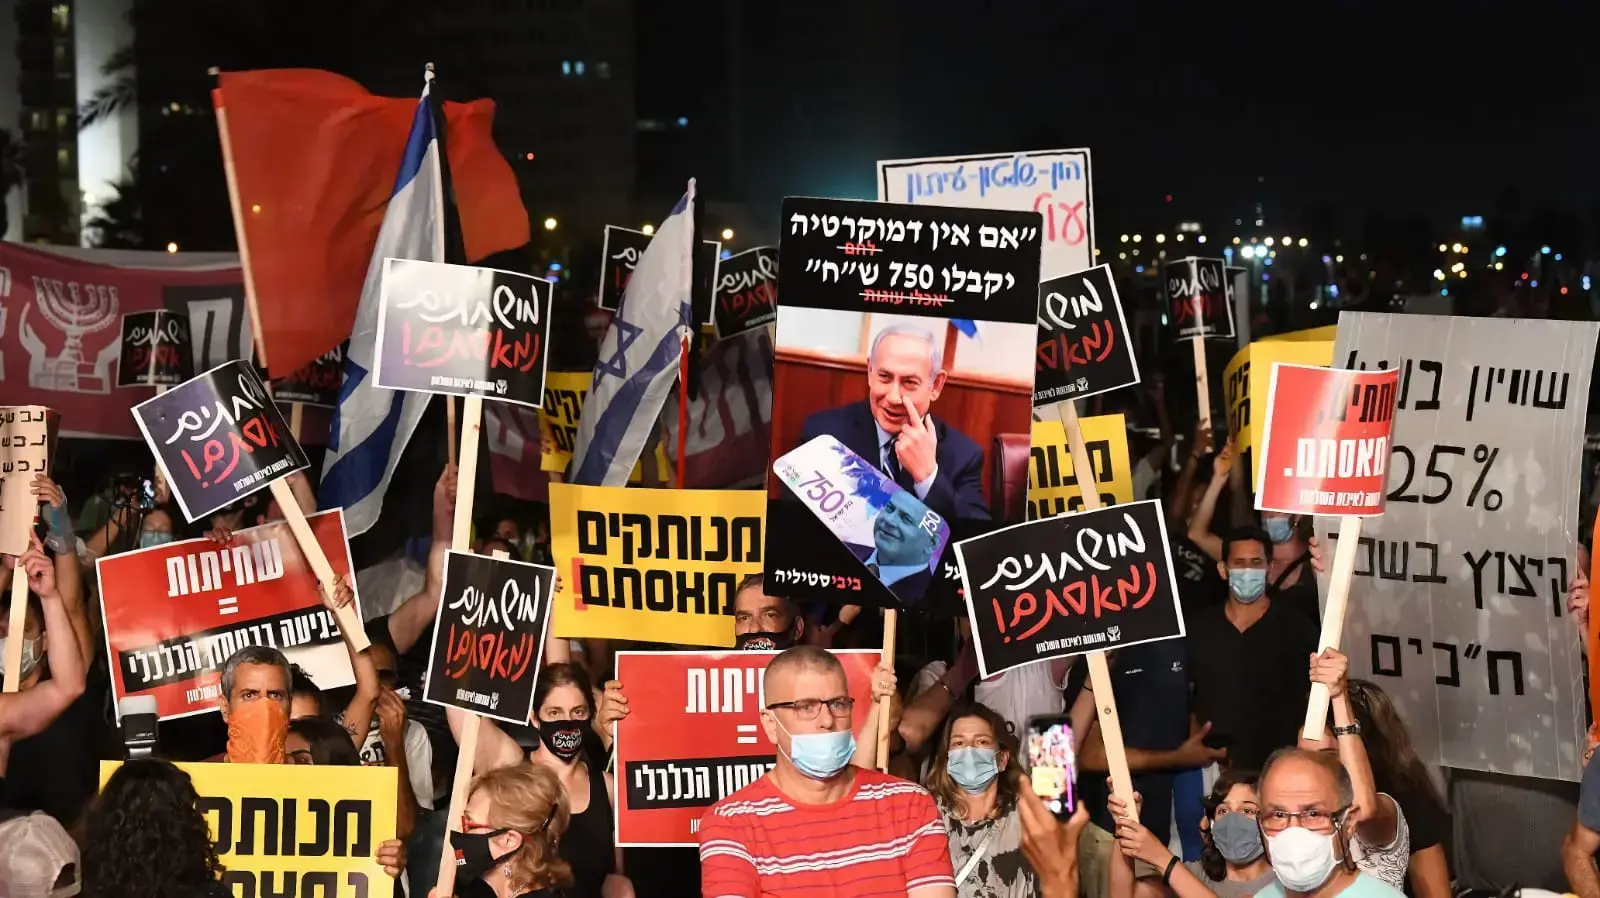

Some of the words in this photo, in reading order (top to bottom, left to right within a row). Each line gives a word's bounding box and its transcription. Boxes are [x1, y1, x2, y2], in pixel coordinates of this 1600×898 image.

[790, 212, 923, 245] דמוקרטיה
[844, 240, 876, 257] לחם
[929, 220, 971, 252] אין
[889, 261, 934, 290] 750
[941, 262, 1015, 301] יקבלו
[396, 284, 539, 330] מושחתים
[402, 320, 540, 372] נמאסתם!
[1036, 319, 1114, 373] נמאס
[1284, 435, 1390, 480] מאסתם.
[1386, 443, 1504, 512] 25%
[798, 469, 845, 513] 750
[577, 510, 761, 565] מנותקים
[918, 509, 942, 537] 750
[166, 538, 285, 598] שחיתות
[980, 512, 1146, 591] מושחתים
[449, 574, 541, 631] מושחתים
[571, 557, 758, 617] מאסתם!
[774, 568, 862, 591] ביביסטיליה
[992, 561, 1157, 644] נמאסתם!
[1462, 549, 1568, 618] קיצוץ
[128, 638, 202, 684] הכלכלי
[445, 623, 535, 683] נמאסתם!
[685, 667, 766, 714] יתות
[635, 763, 711, 801] הכלכלי
[199, 796, 372, 858] מנותק
